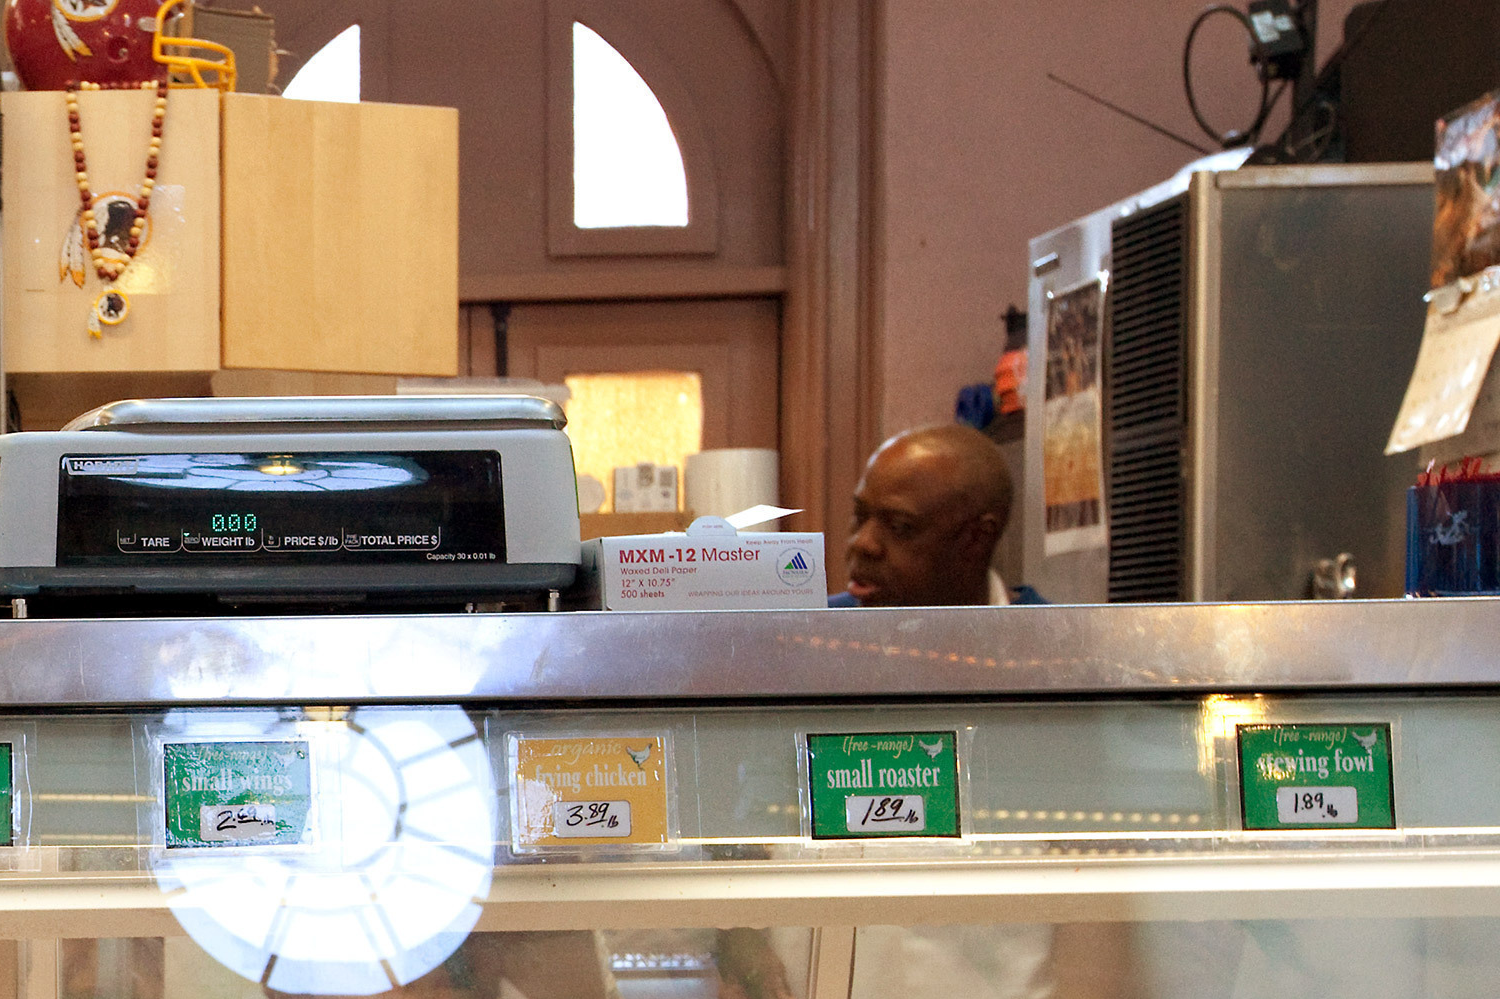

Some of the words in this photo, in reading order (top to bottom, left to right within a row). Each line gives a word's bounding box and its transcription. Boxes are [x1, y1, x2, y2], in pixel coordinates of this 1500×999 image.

[212, 513, 257, 532] 0.00
[141, 537, 170, 547] TARE
[201, 536, 244, 547] WEIGHT
[245, 536, 255, 546] lb
[284, 536, 316, 546] PRICE
[318, 536, 339, 547] $/lb
[361, 535, 395, 545] TOTAL
[397, 535, 429, 545] PRICE
[431, 535, 438, 546] $
[426, 552, 456, 561] Capacity
[457, 552, 466, 560] 30
[472, 552, 487, 560] 0.01
[489, 552, 496, 560] lb
[619, 549, 665, 564] MXM
[701, 547, 760, 562] Master
[620, 567, 650, 576] Waxed
[652, 566, 670, 575] Deli
[671, 566, 697, 577] Paper
[638, 579, 644, 588] X
[621, 589, 638, 599] 500
[639, 589, 665, 599] sheets
[550, 742, 622, 765] organic
[1335, 748, 1375, 772] fowl
[585, 763, 647, 786] chicken
[827, 758, 873, 789] small
[878, 763, 941, 788] roaster
[182, 767, 232, 792] small
[243, 767, 293, 796] wings
